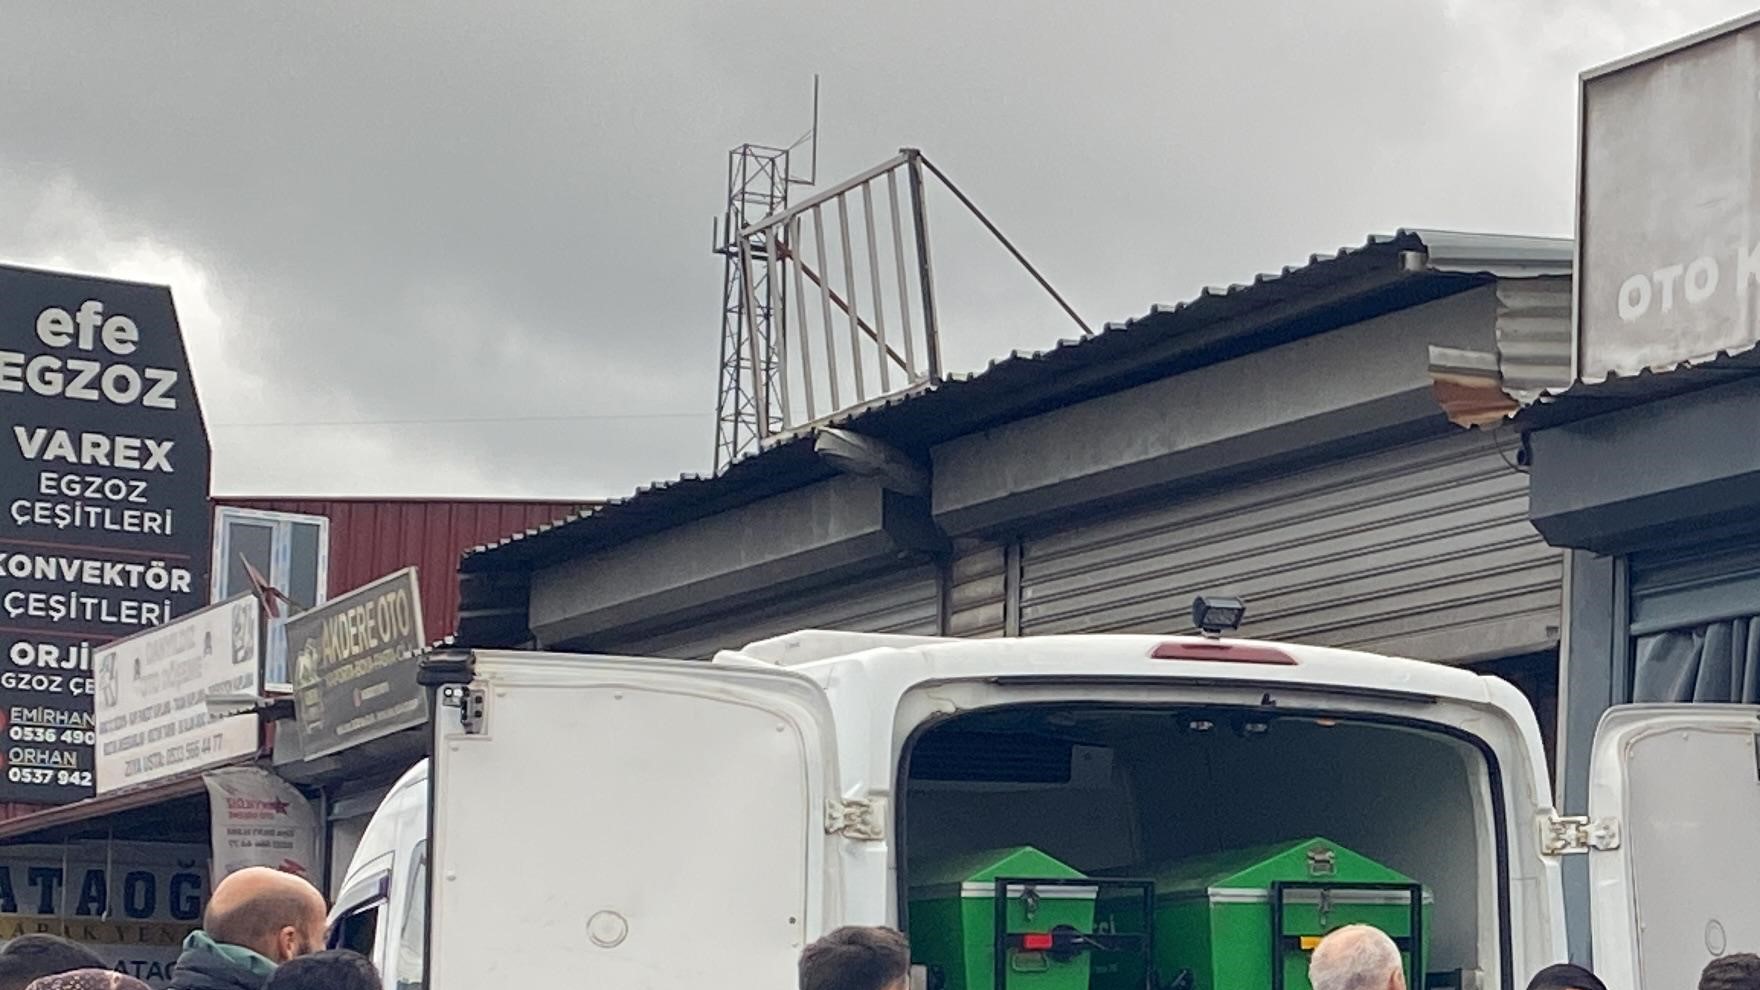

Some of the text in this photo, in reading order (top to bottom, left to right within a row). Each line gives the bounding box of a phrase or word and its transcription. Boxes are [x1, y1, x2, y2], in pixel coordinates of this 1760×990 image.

[1617, 255, 1719, 323] OTO
[36, 300, 139, 355] efe
[0, 351, 178, 410] EGZOZ
[13, 426, 175, 472] VAREX
[39, 472, 148, 503] EGZOZ
[11, 500, 172, 535] ÇEŞİTLERİ
[4, 591, 171, 625] ÇEŞİTLERİ
[321, 589, 411, 664] AKDERE OTO
[10, 641, 89, 671] ORJİ
[1, 672, 63, 692] GZOZ
[10, 706, 95, 727] EMİRHAN
[9, 726, 95, 745] 0536 490
[9, 747, 77, 766] ORHAN
[8, 767, 93, 787] 0537 942
